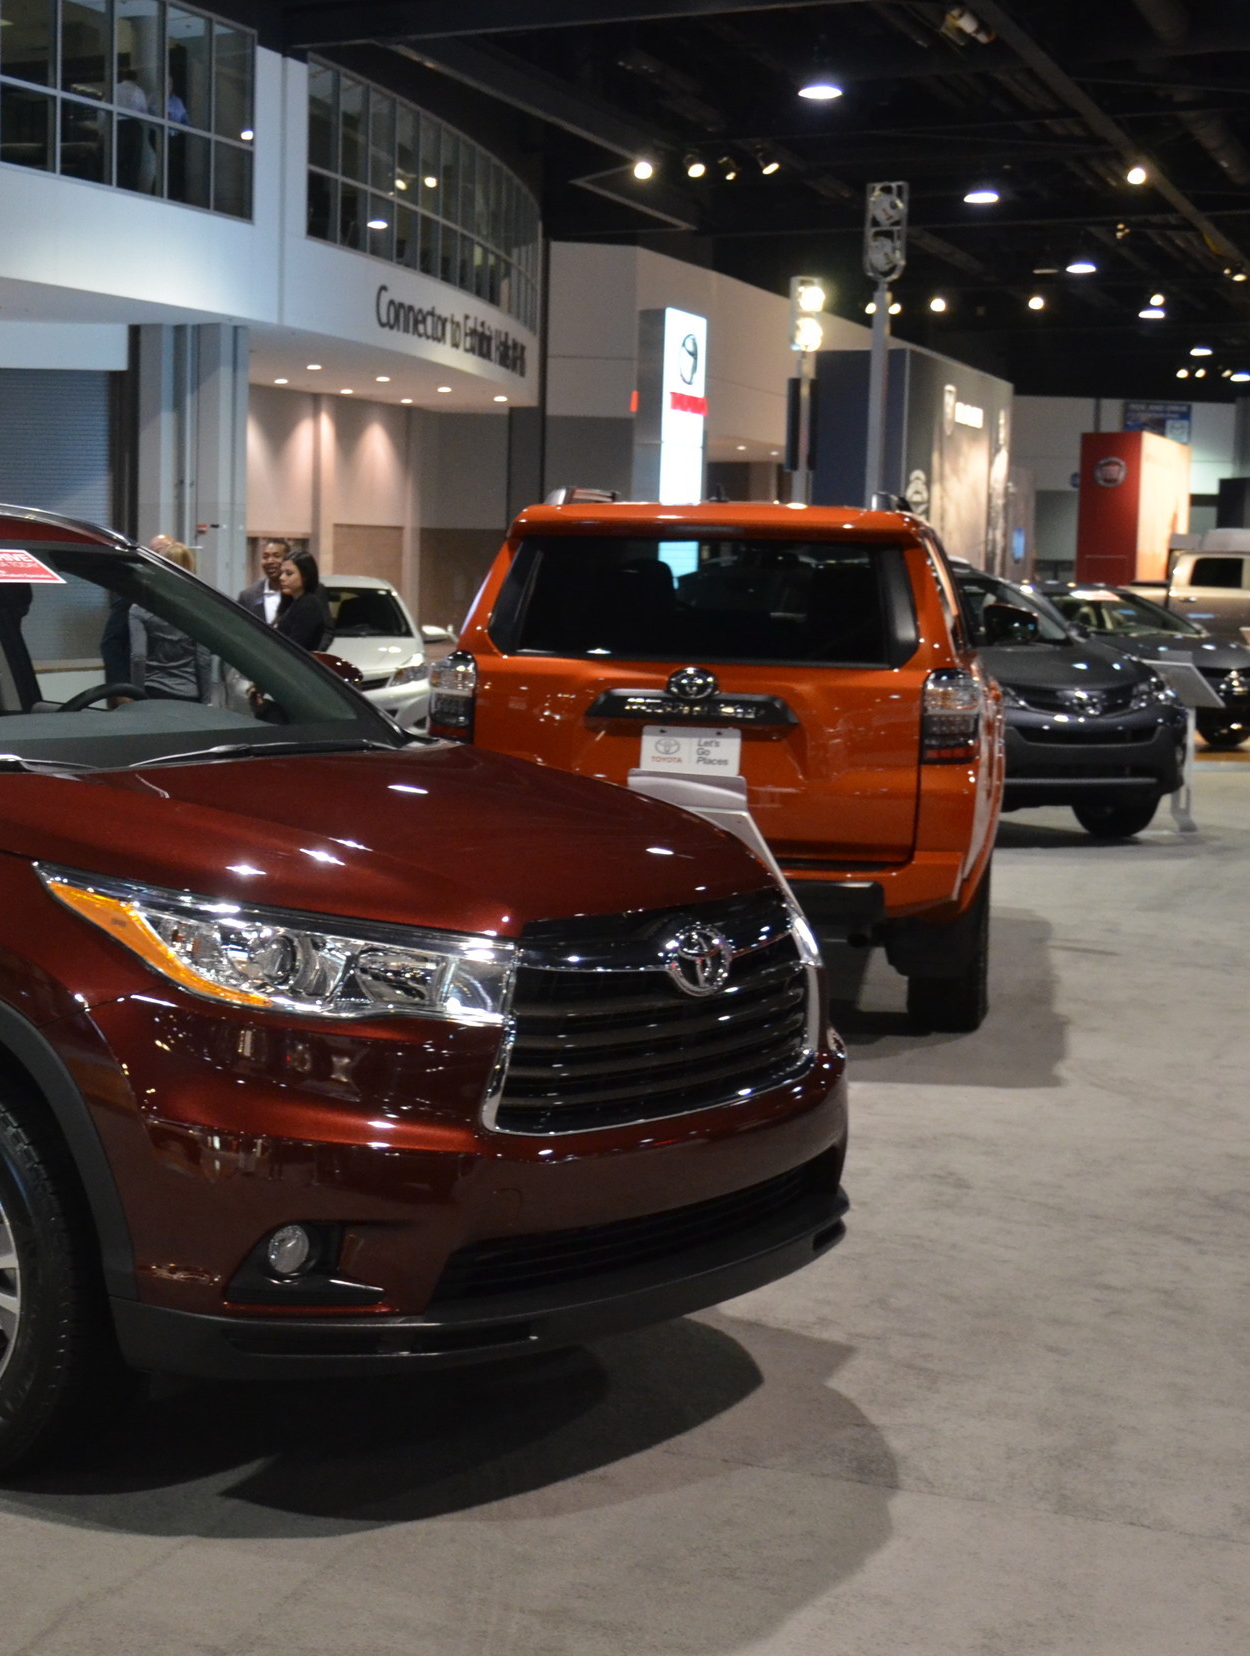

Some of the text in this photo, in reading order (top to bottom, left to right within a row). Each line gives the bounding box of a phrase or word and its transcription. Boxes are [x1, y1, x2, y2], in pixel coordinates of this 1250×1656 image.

[376, 284, 448, 345] Connector
[450, 313, 463, 349] to
[697, 739, 721, 748] Let's
[696, 747, 711, 757] Go
[696, 756, 729, 766] Places
